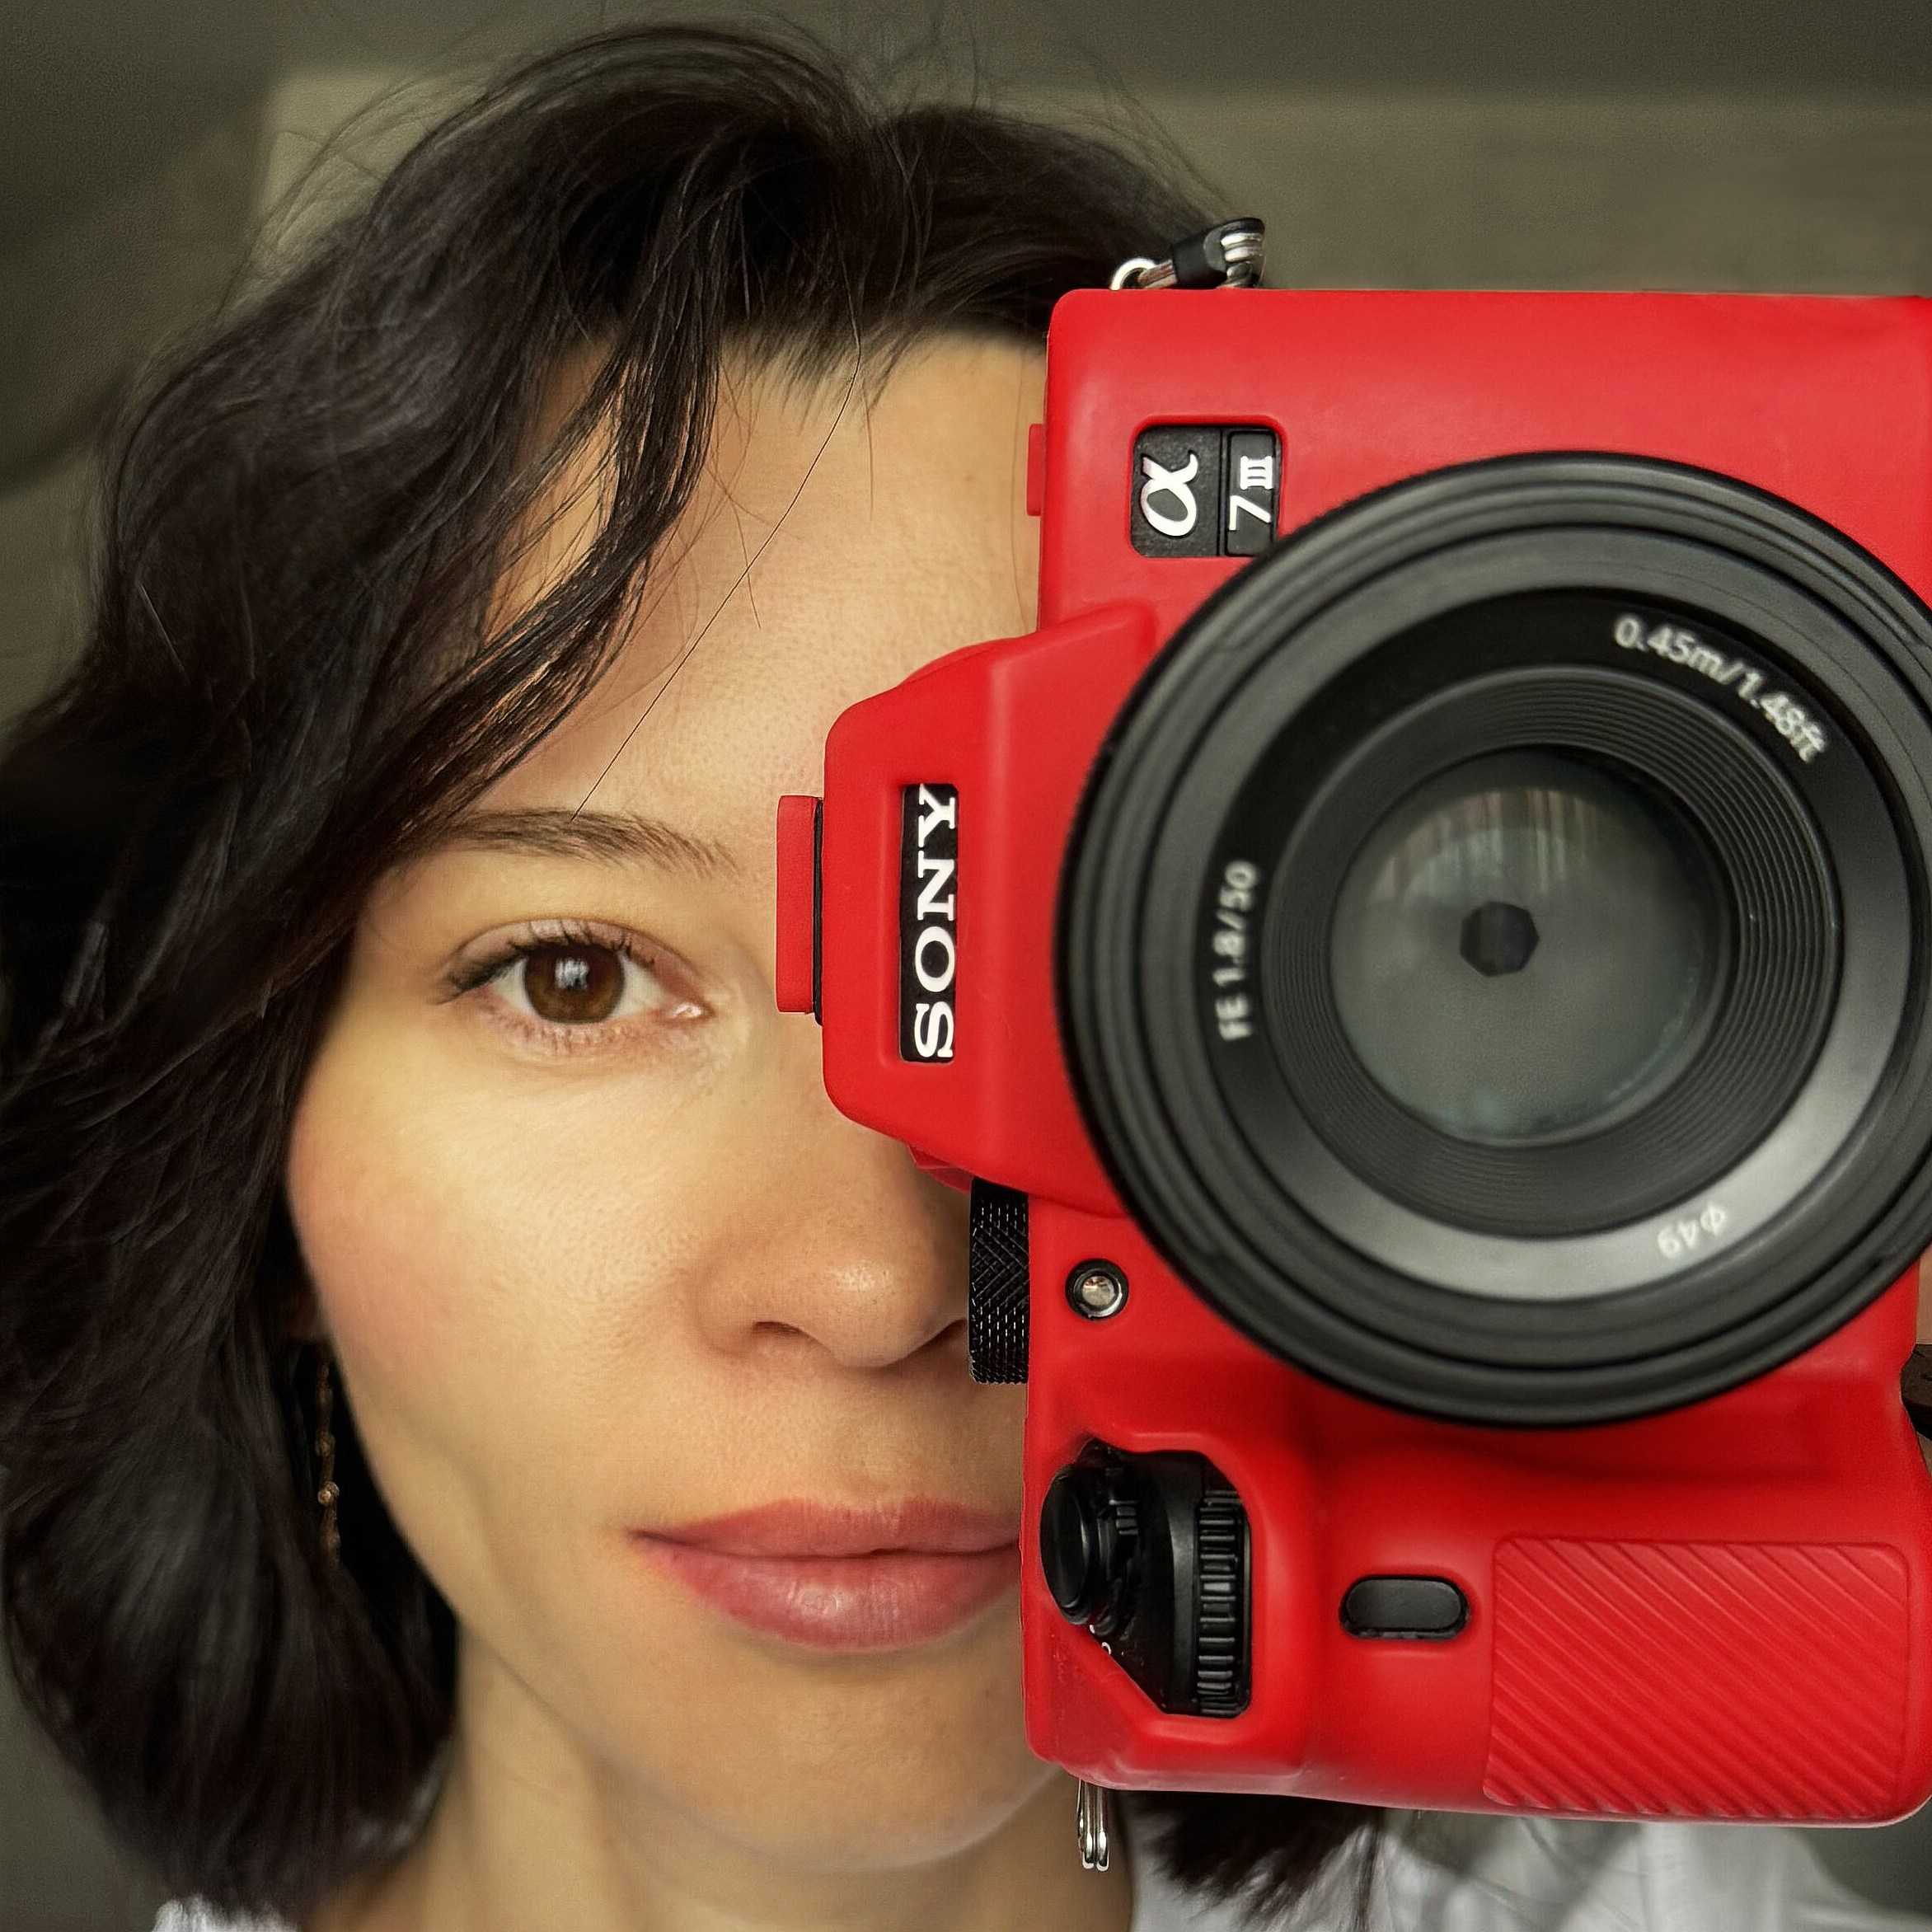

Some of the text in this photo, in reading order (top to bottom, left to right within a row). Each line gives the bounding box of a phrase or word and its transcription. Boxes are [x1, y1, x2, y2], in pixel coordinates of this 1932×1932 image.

[915, 783, 954, 1057] SONY
[1212, 860, 1257, 1040] FE 1.8/50
